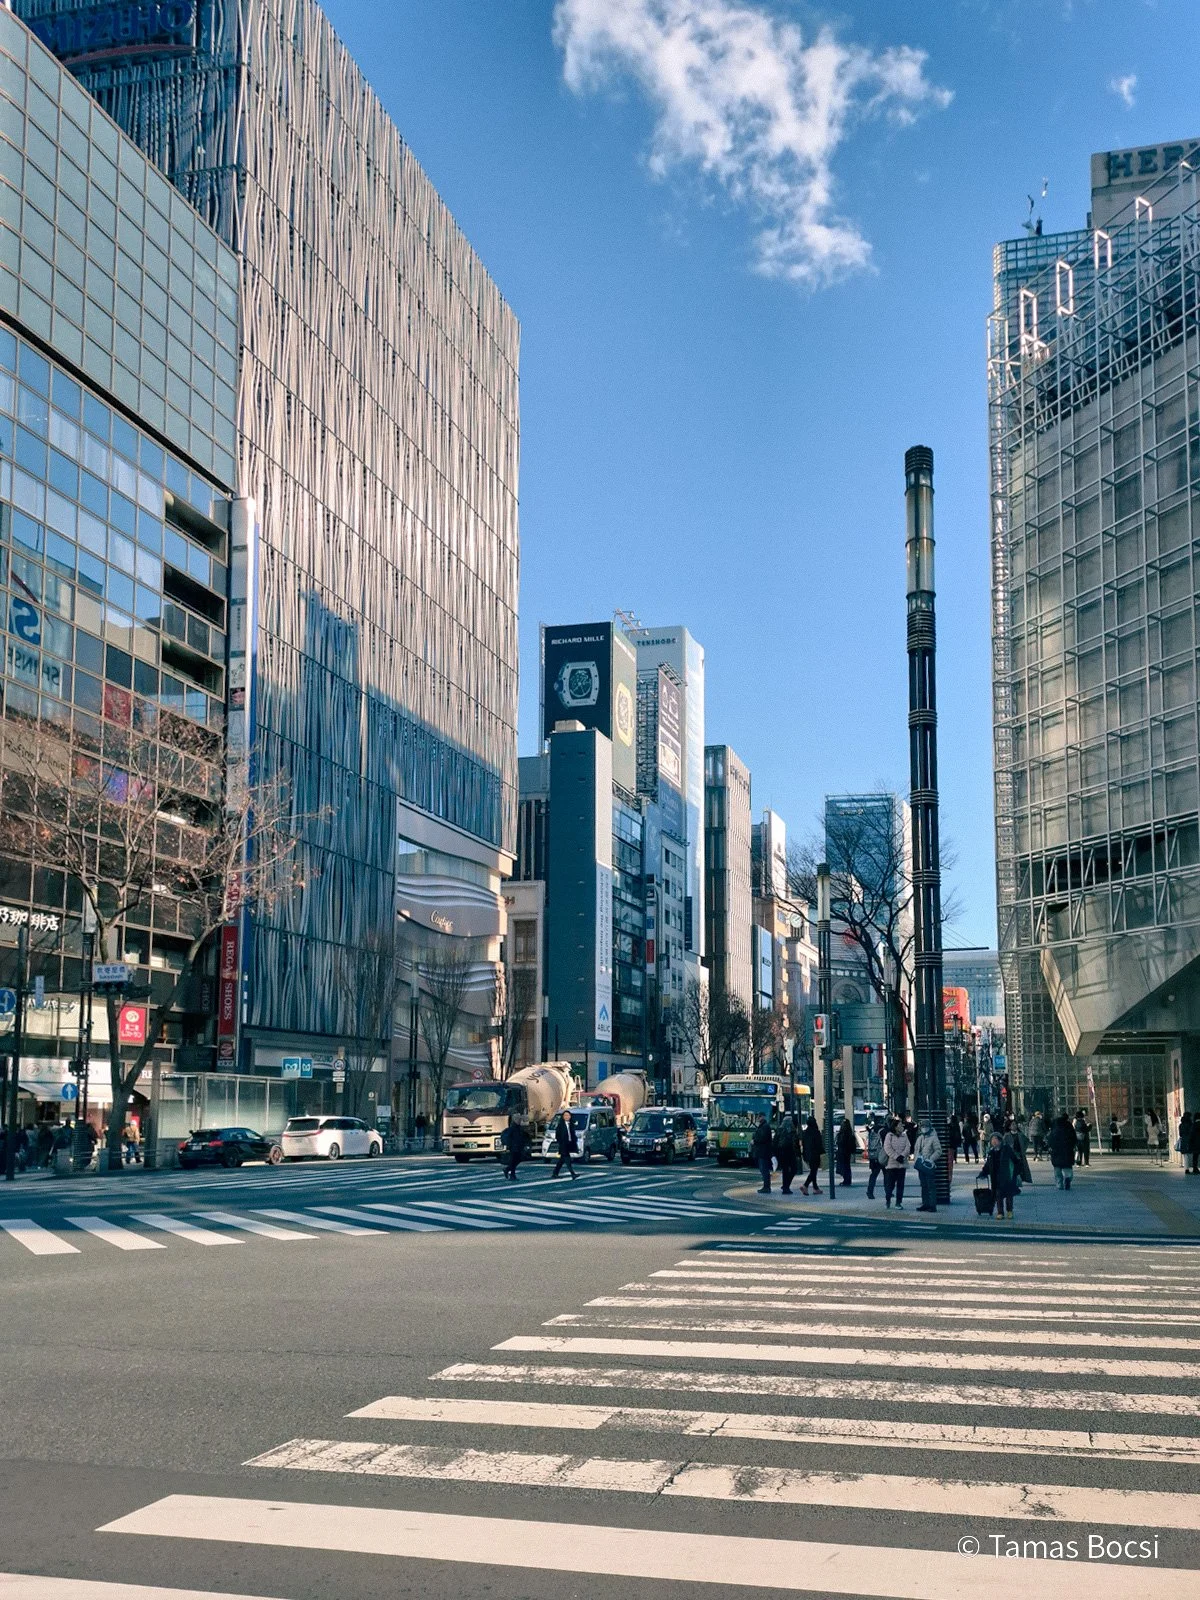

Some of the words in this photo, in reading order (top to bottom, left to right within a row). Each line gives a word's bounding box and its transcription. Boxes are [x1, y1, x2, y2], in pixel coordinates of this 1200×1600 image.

[32, 1, 194, 53] MIZUHO
[1110, 143, 1200, 179] HER
[551, 637, 582, 645] RICHARD
[224, 941, 235, 979] REGAL
[223, 982, 233, 1021] SHOES
